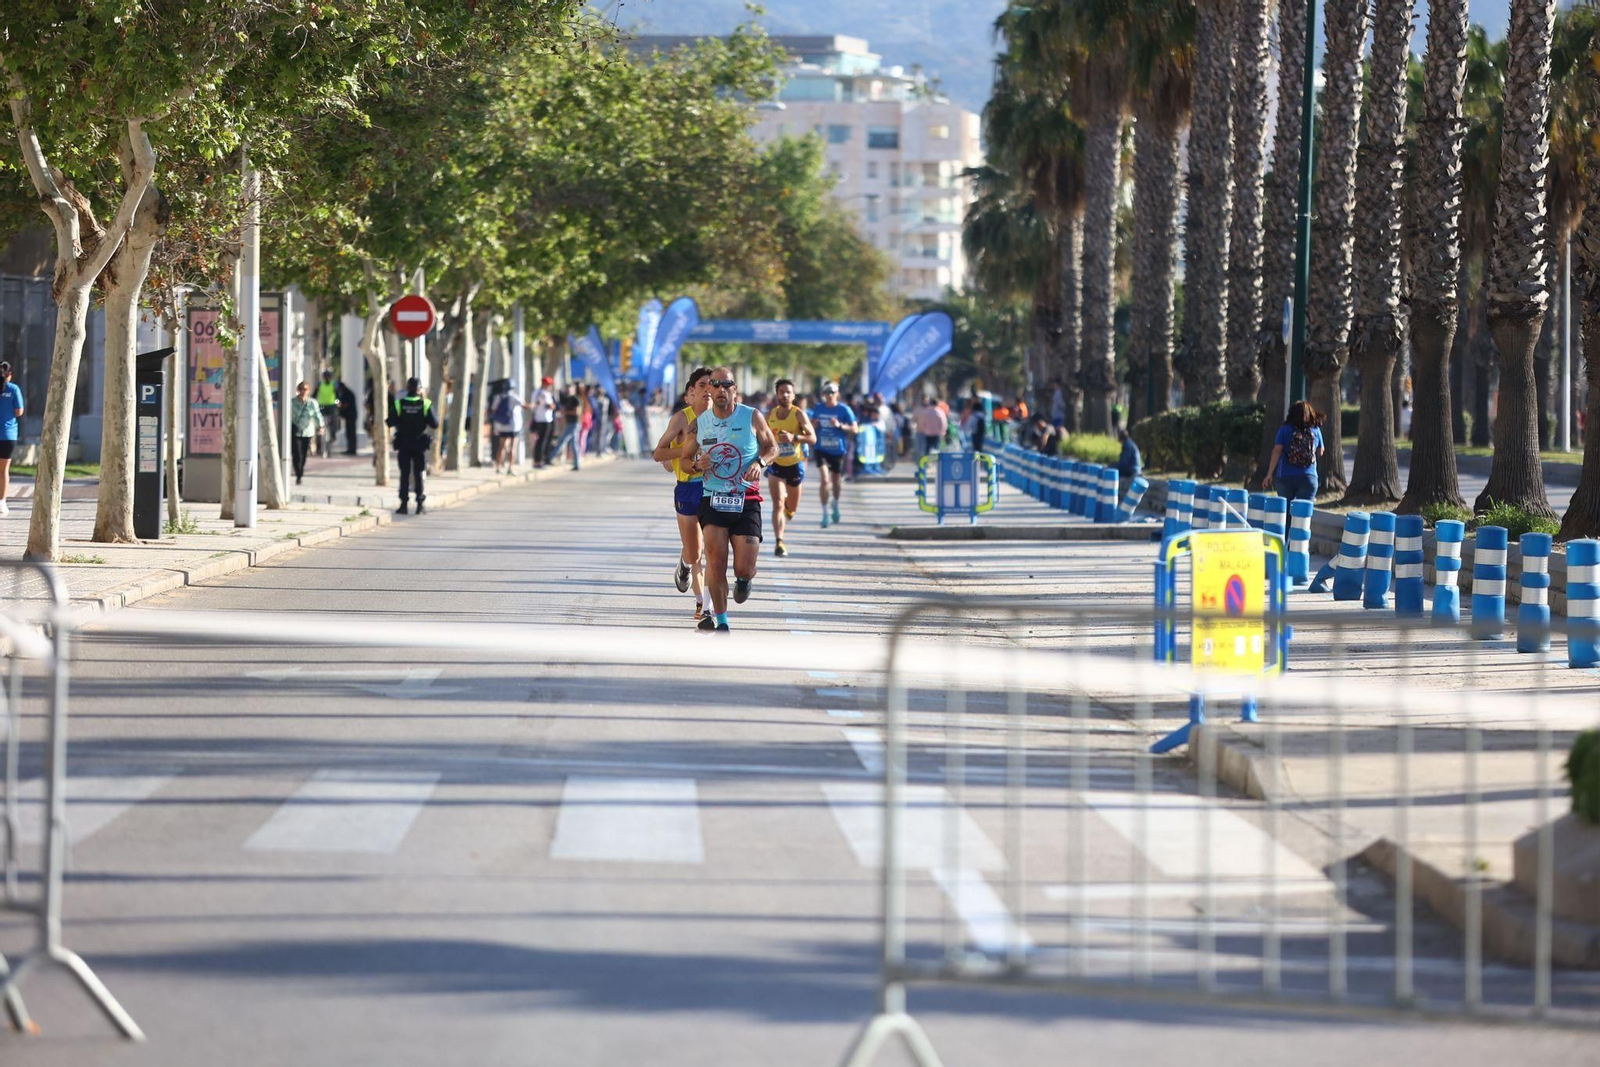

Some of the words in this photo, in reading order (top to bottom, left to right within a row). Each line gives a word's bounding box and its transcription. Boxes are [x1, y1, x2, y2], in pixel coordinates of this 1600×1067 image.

[194, 321, 214, 336] 06
[887, 325, 941, 379] mayoral
[142, 385, 155, 400] P
[715, 497, 740, 505] 1669
